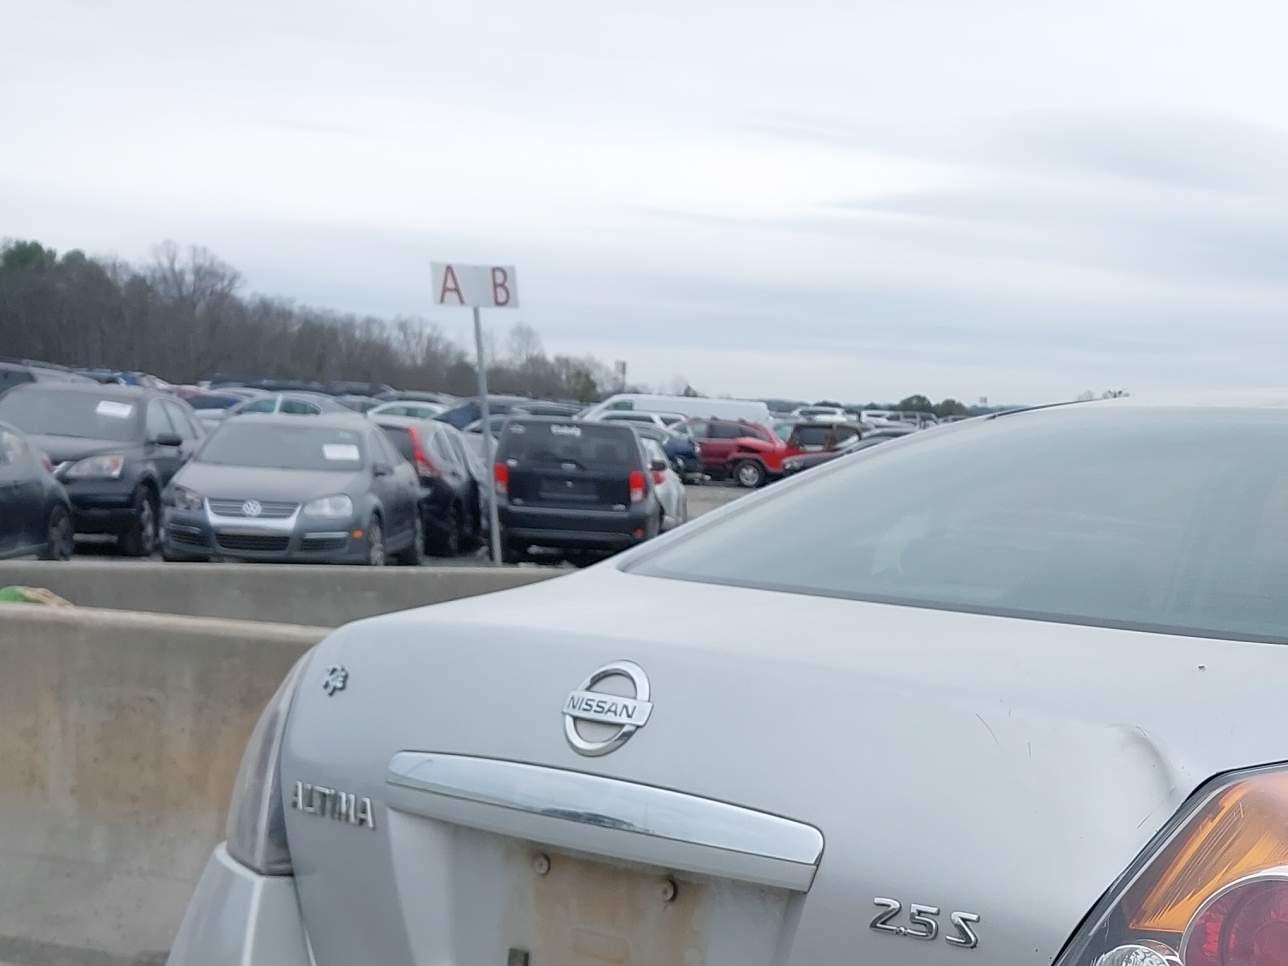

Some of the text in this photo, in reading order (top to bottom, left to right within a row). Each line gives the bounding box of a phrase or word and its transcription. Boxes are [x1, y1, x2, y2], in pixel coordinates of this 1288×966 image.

[439, 264, 511, 308] A B
[566, 694, 638, 719] NISSAN
[291, 780, 377, 831] ALTIMA
[944, 911, 981, 949] S
